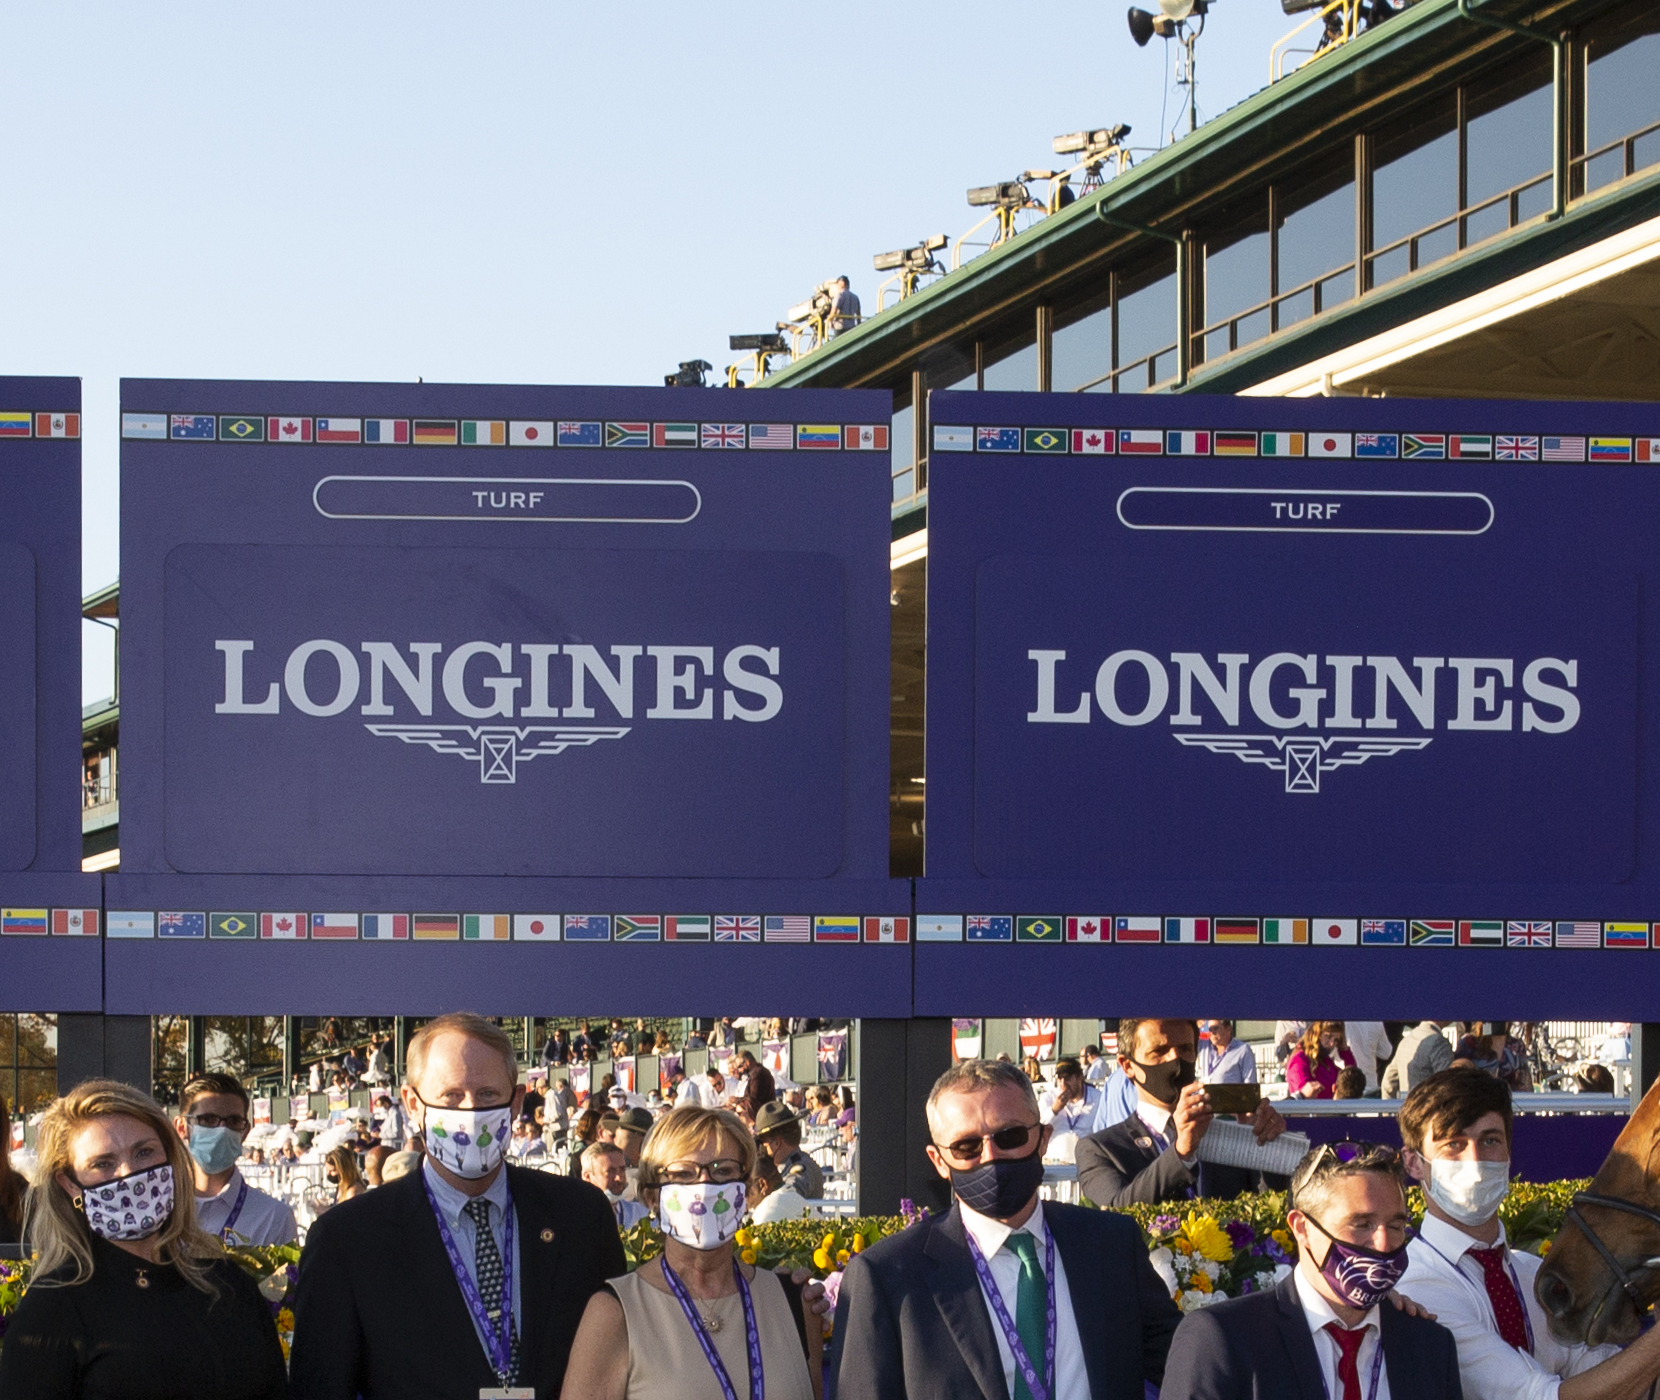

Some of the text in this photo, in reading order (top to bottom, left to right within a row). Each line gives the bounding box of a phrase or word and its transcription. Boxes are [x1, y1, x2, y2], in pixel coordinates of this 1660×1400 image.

[472, 490, 545, 509] TURF
[1270, 502, 1342, 521] TURF
[214, 638, 784, 723] LONGINES
[1027, 648, 1581, 734] LONGINES
